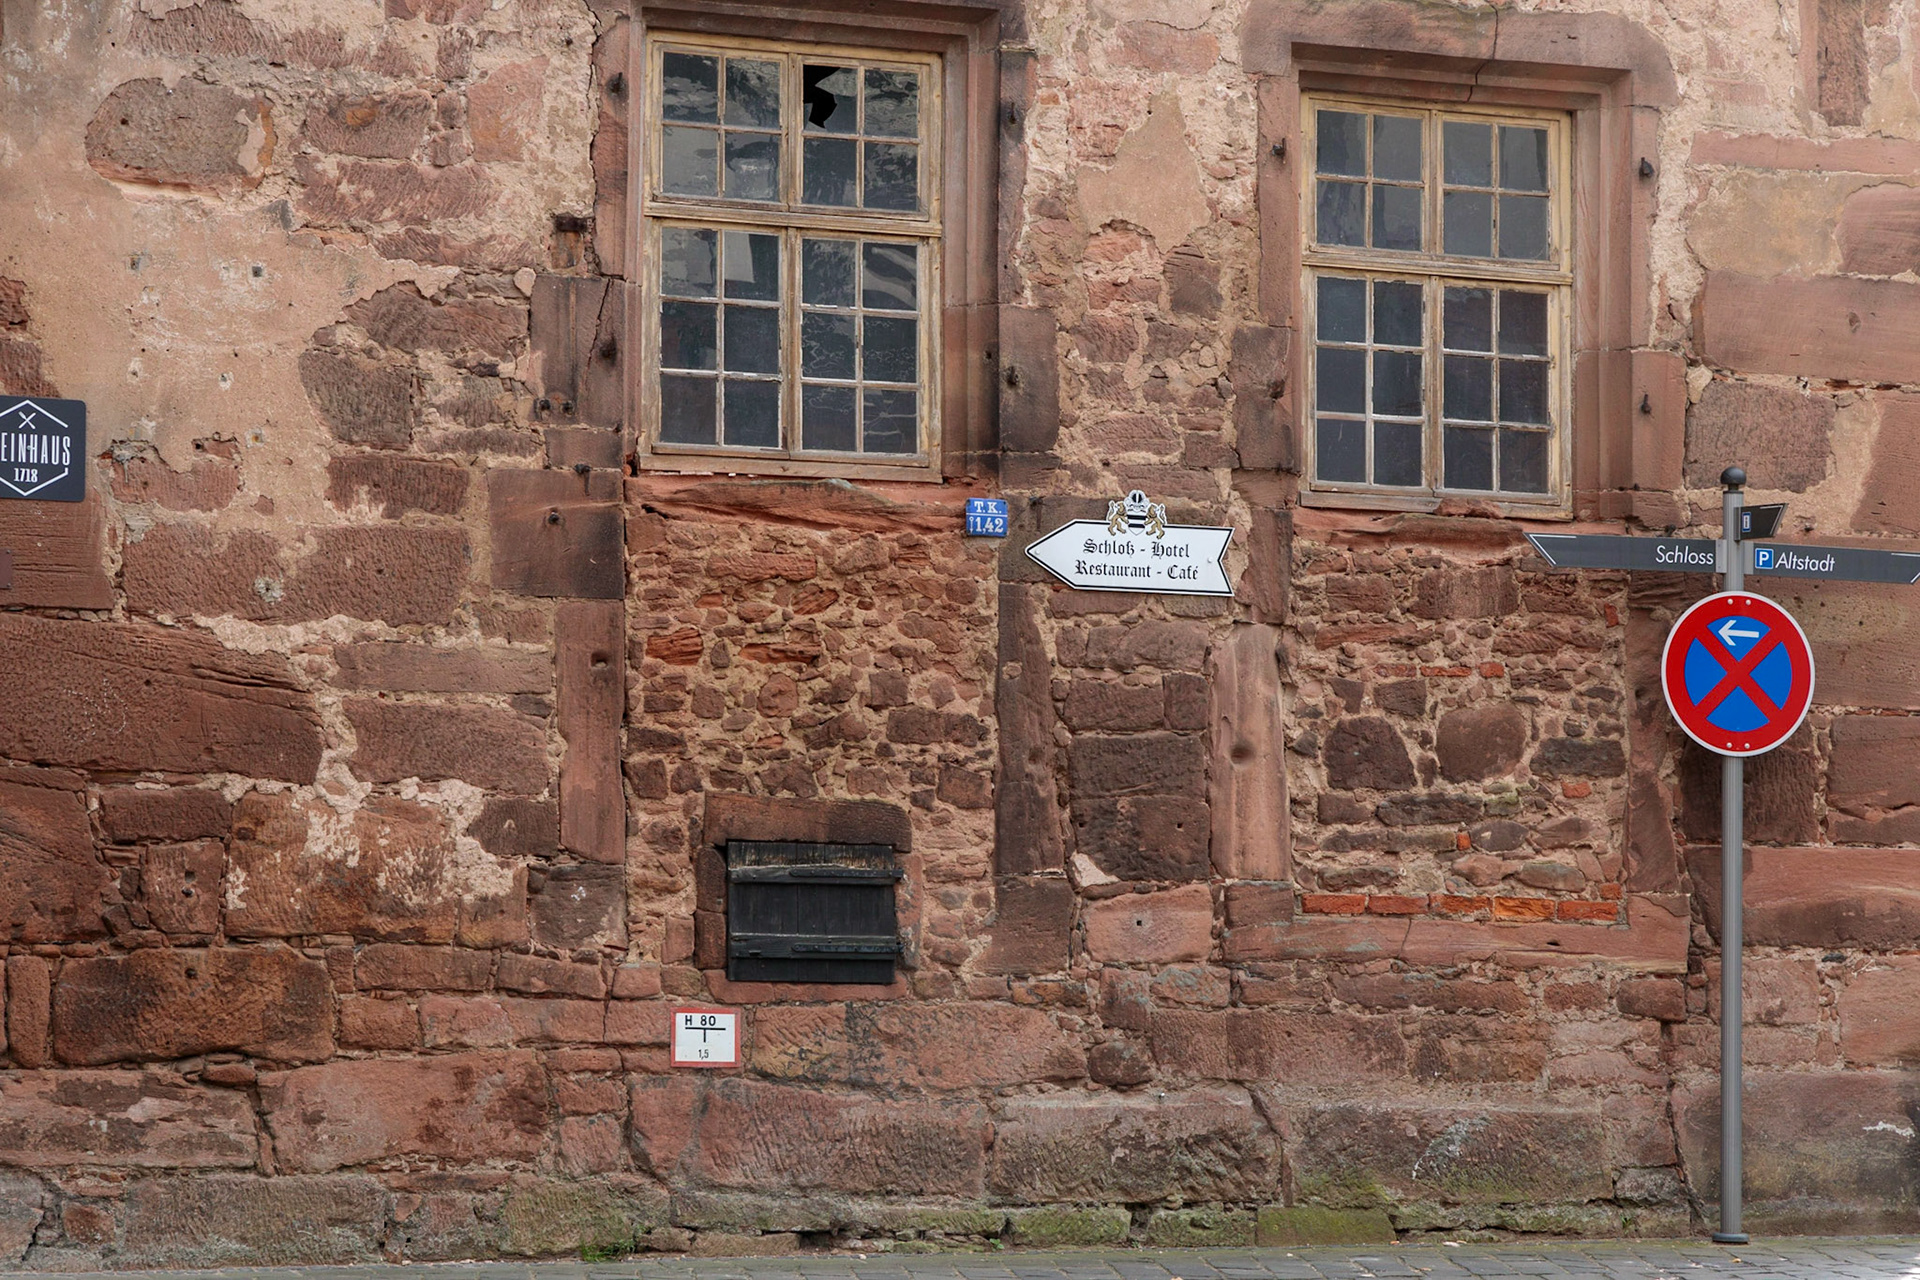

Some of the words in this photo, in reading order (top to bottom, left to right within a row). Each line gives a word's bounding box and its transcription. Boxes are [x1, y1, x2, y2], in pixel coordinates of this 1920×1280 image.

[1, 432, 71, 466] EINHAUS
[13, 467, 38, 483] 1718
[975, 516, 1004, 535] 1,42
[1083, 538, 1135, 558] Schloß
[1151, 541, 1190, 559] Hotel
[1655, 545, 1714, 565] Schloss
[1074, 559, 1151, 578] Restaurant
[1167, 564, 1199, 580] Café
[1775, 552, 1835, 572] Altstadt
[685, 1015, 693, 1026] H
[700, 1015, 716, 1026] 80
[698, 1049, 709, 1060] 1,5
